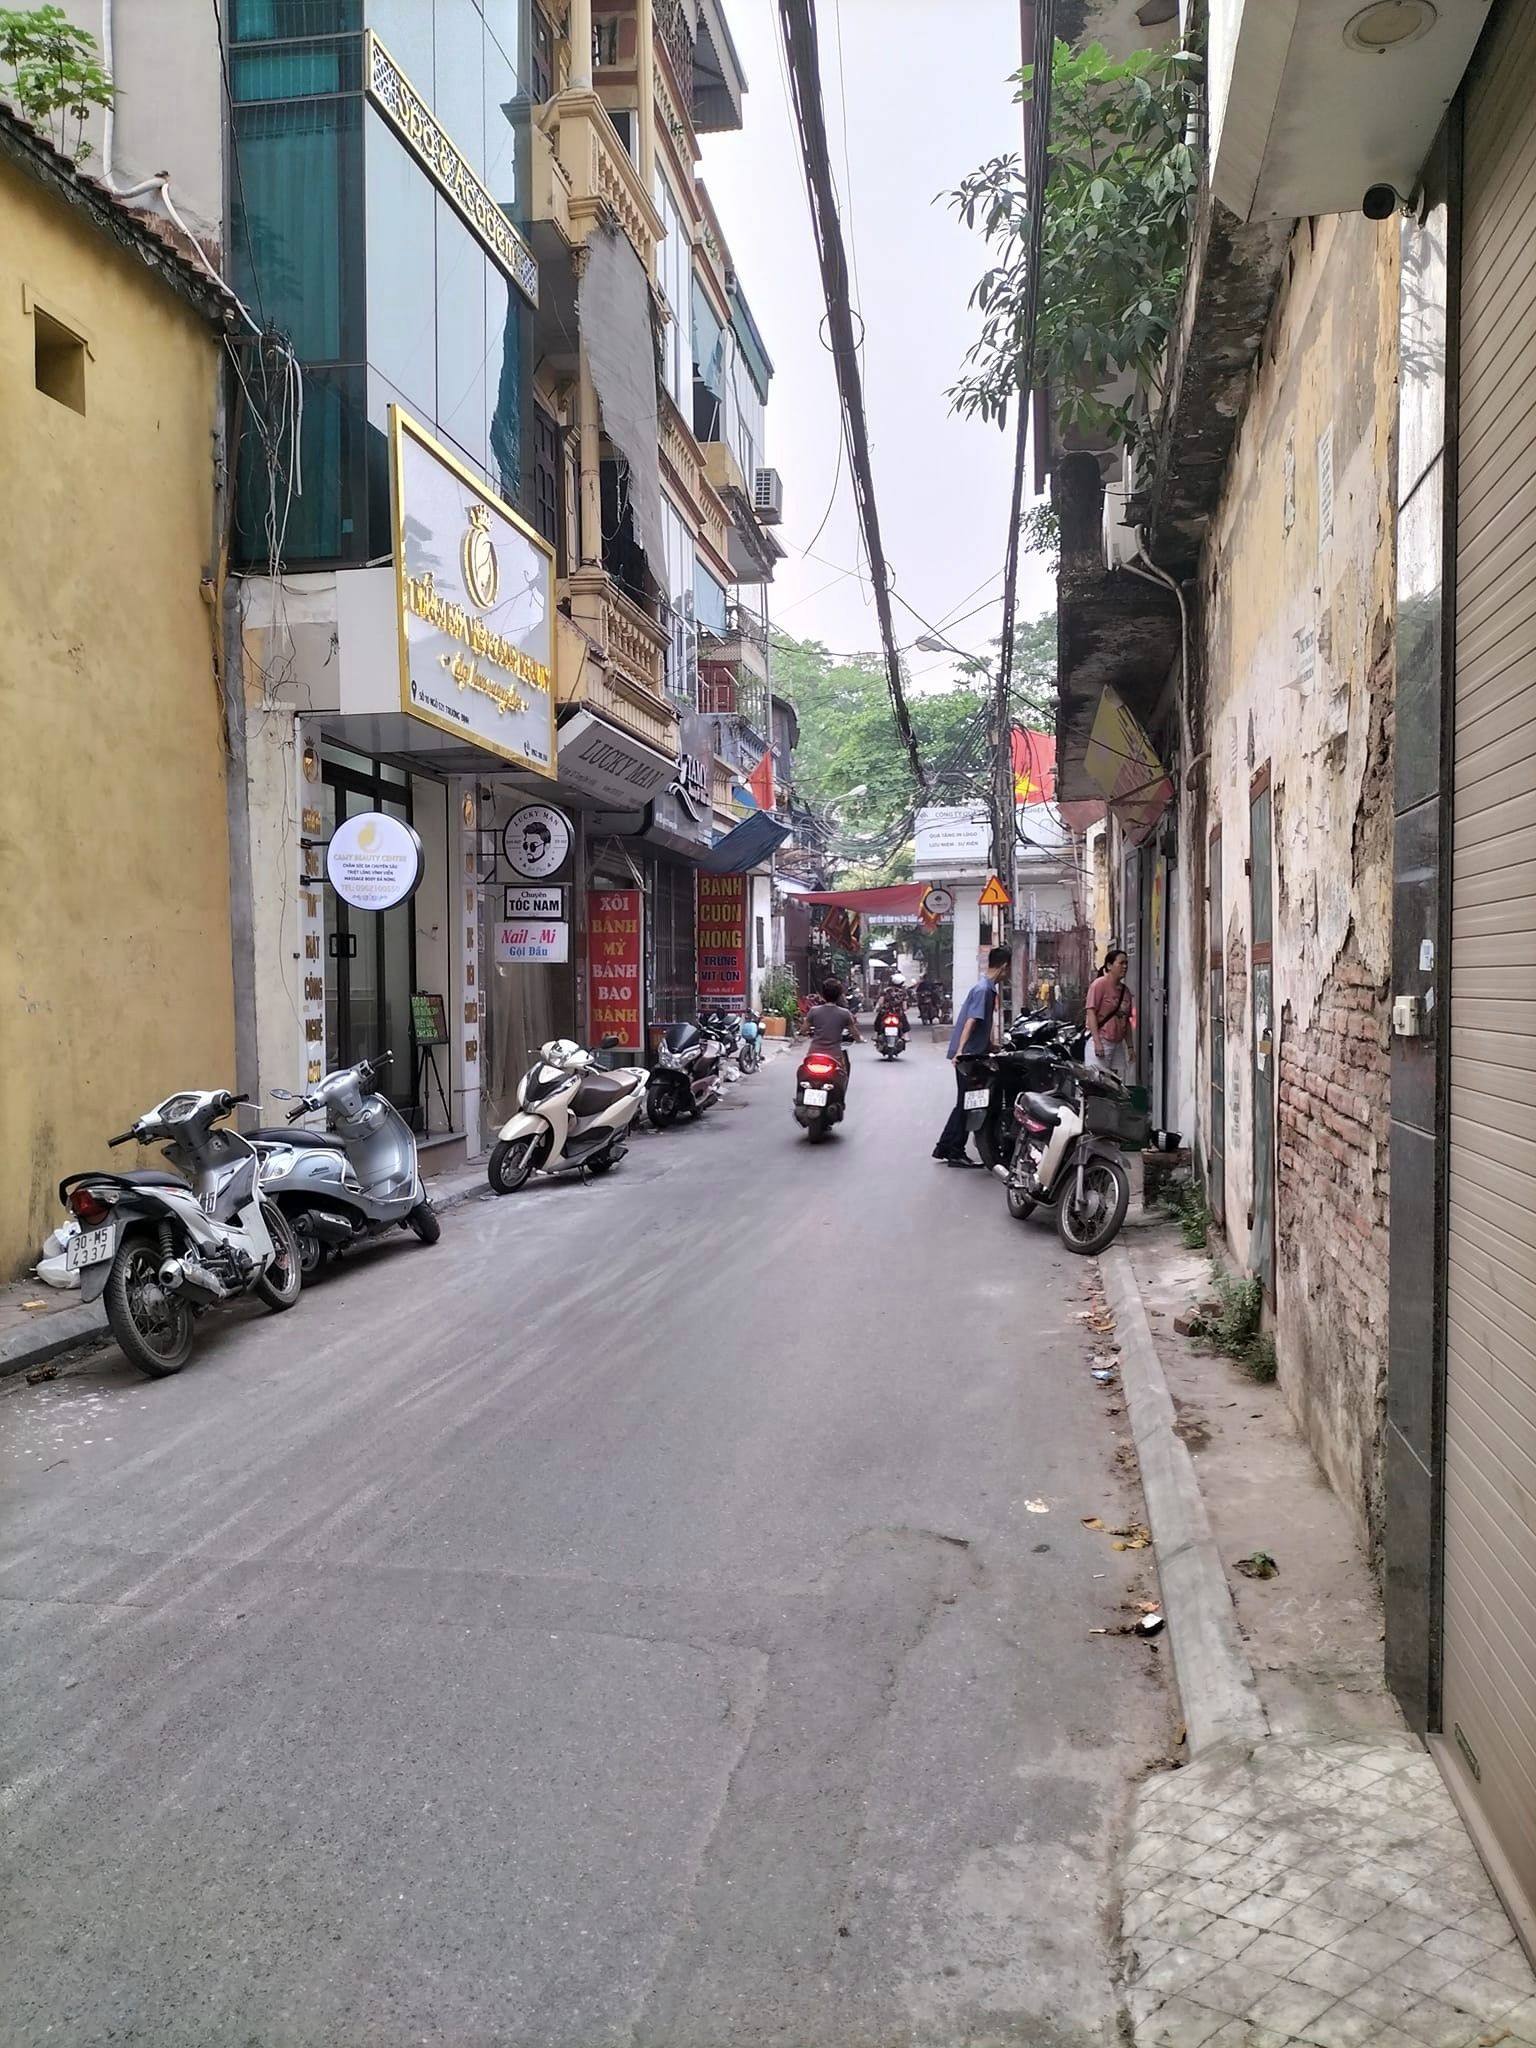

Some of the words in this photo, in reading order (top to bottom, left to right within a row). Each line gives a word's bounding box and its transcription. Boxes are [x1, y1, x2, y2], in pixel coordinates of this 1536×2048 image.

[578, 739, 638, 776] LUCKY
[624, 763, 664, 790] MAN
[513, 810, 539, 827] LUCKY
[543, 811, 558, 826] MAN
[520, 891, 548, 899] Chuyên
[600, 893, 629, 911] XÔI
[509, 897, 530, 911] TÓC
[533, 900, 560, 911] NAM
[592, 915, 638, 933] BÁNH
[501, 929, 529, 945] Nail
[592, 961, 638, 978] BÁNH
[598, 986, 632, 1000] BAO
[593, 1004, 638, 1022] BÁNH
[73, 1228, 108, 1252] 30-M5
[72, 1243, 107, 1267] 4337
